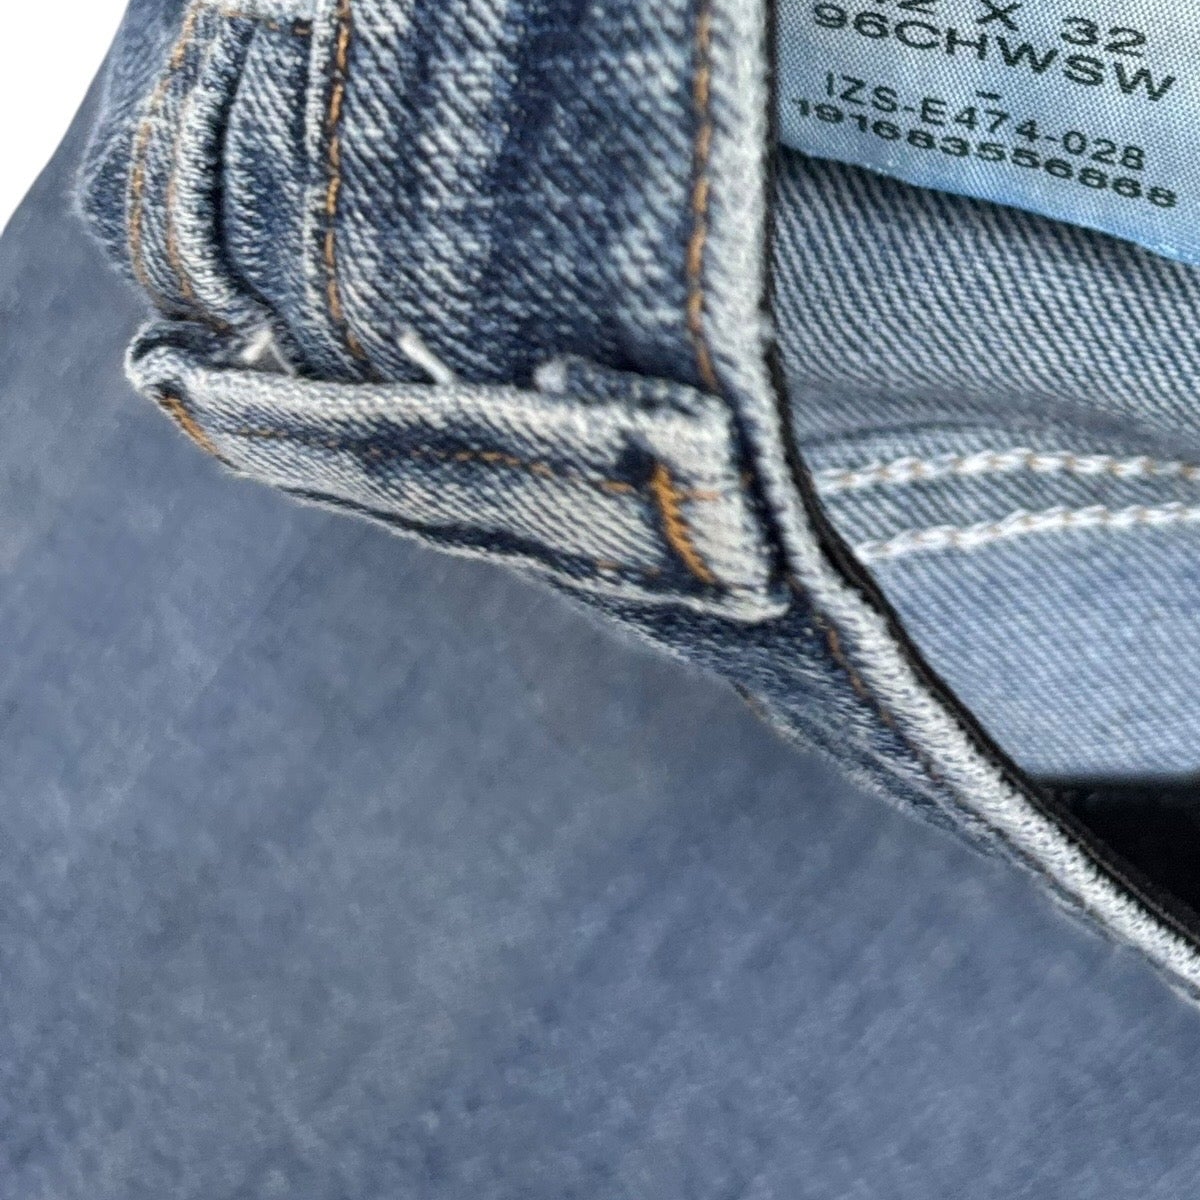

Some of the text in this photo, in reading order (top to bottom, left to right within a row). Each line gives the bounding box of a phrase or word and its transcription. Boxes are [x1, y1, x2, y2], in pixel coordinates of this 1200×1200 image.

[813, 2, 1177, 102] 96CHWSW
[1059, 15, 1147, 59] 32
[826, 72, 1146, 171] IZS-E474-028
